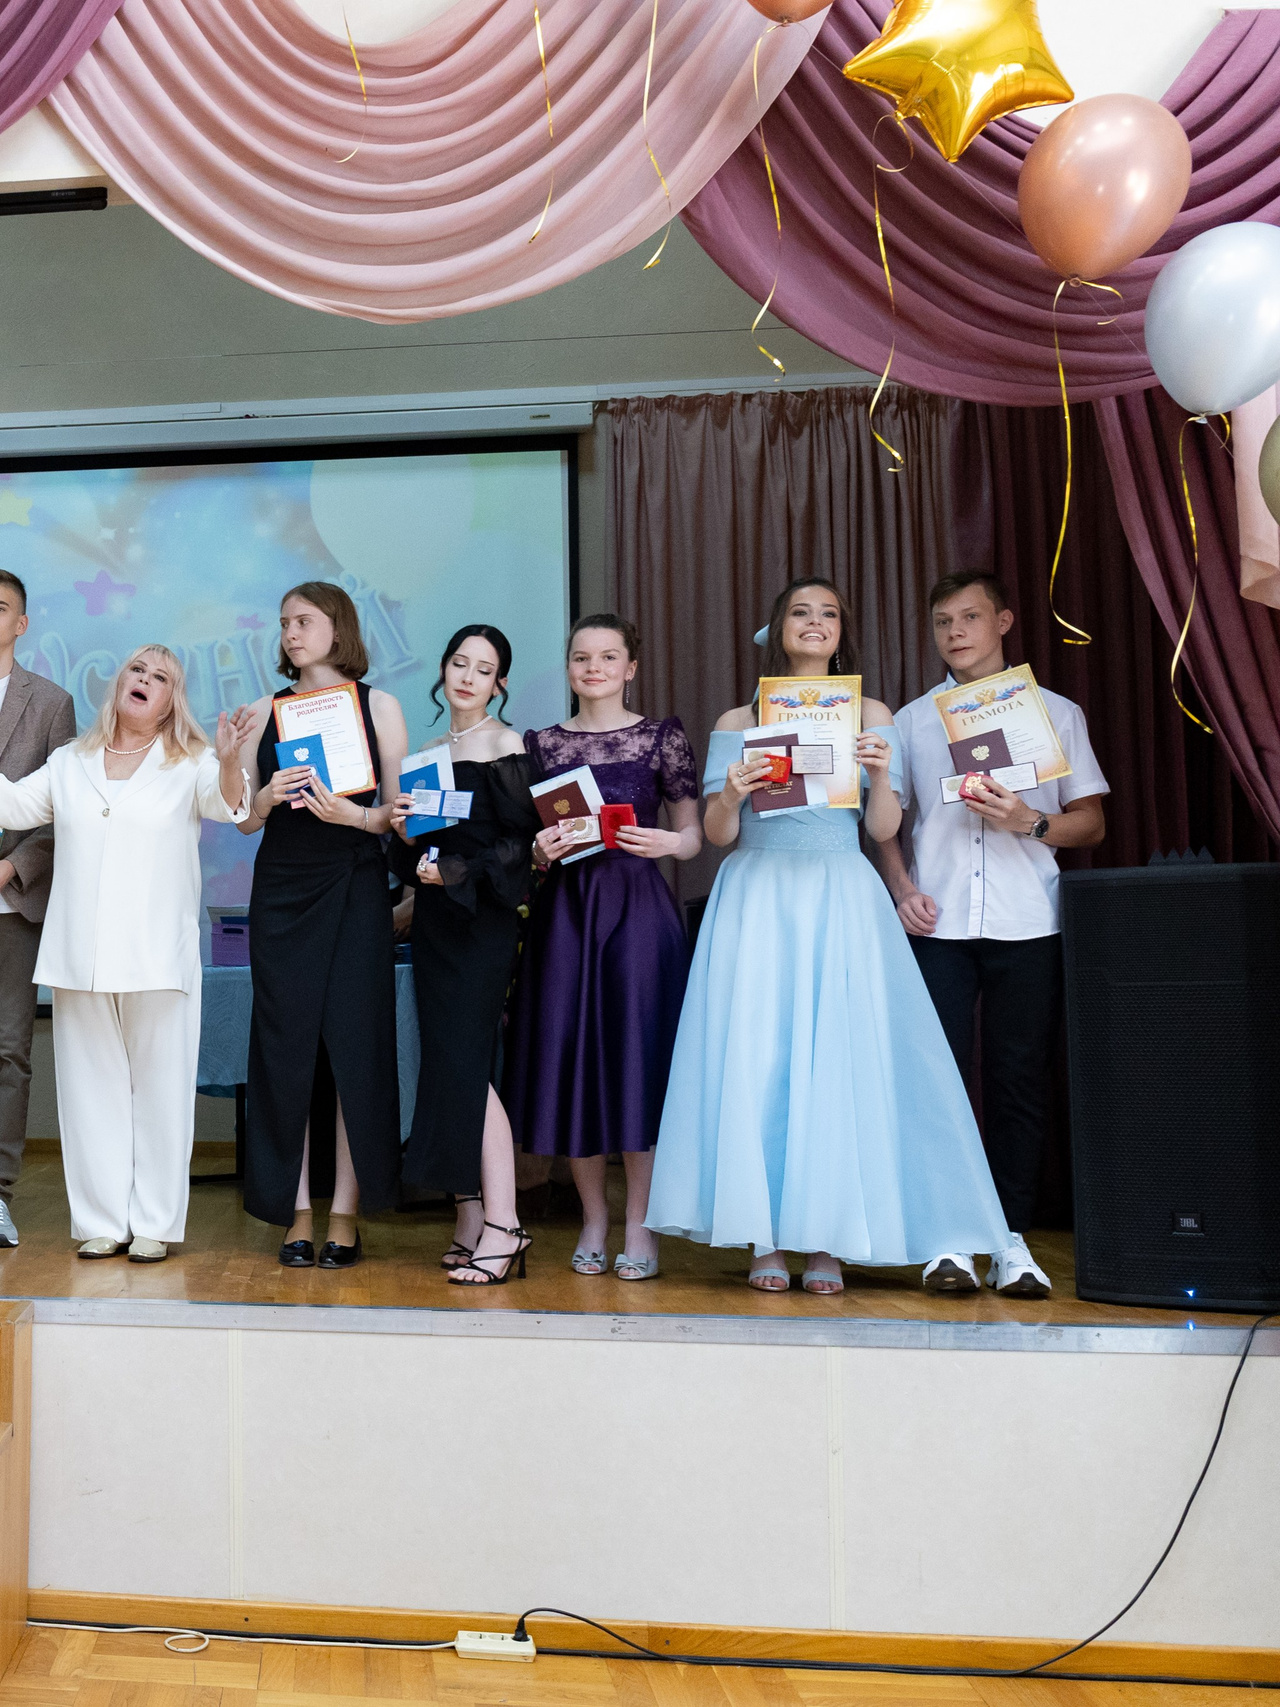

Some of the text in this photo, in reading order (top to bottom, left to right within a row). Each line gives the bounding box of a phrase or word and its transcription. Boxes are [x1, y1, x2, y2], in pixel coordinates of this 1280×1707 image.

[287, 694, 344, 711] Благодарность
[296, 703, 338, 718] родителям
[778, 711, 842, 721] ГРАМОТА
[962, 700, 1024, 726] ГРАМОТА
[1179, 1217, 1198, 1228] JBL
